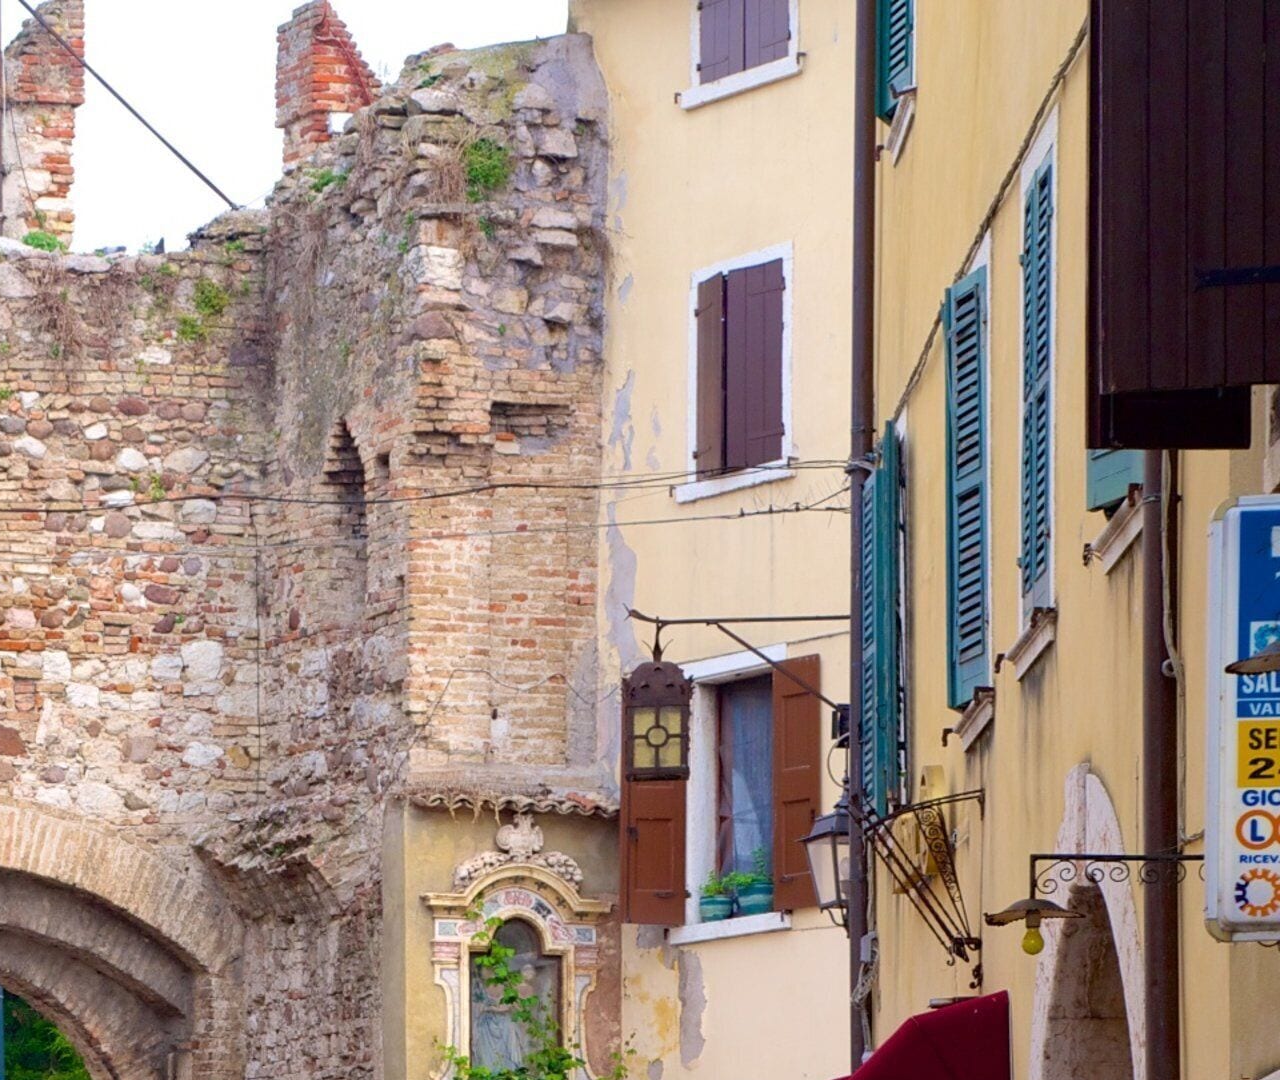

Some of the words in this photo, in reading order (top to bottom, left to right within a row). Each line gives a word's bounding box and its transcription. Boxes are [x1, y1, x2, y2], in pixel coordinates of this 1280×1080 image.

[1248, 727, 1278, 750] SE
[1248, 757, 1280, 779] 2
[1239, 854, 1280, 864] RICEV
